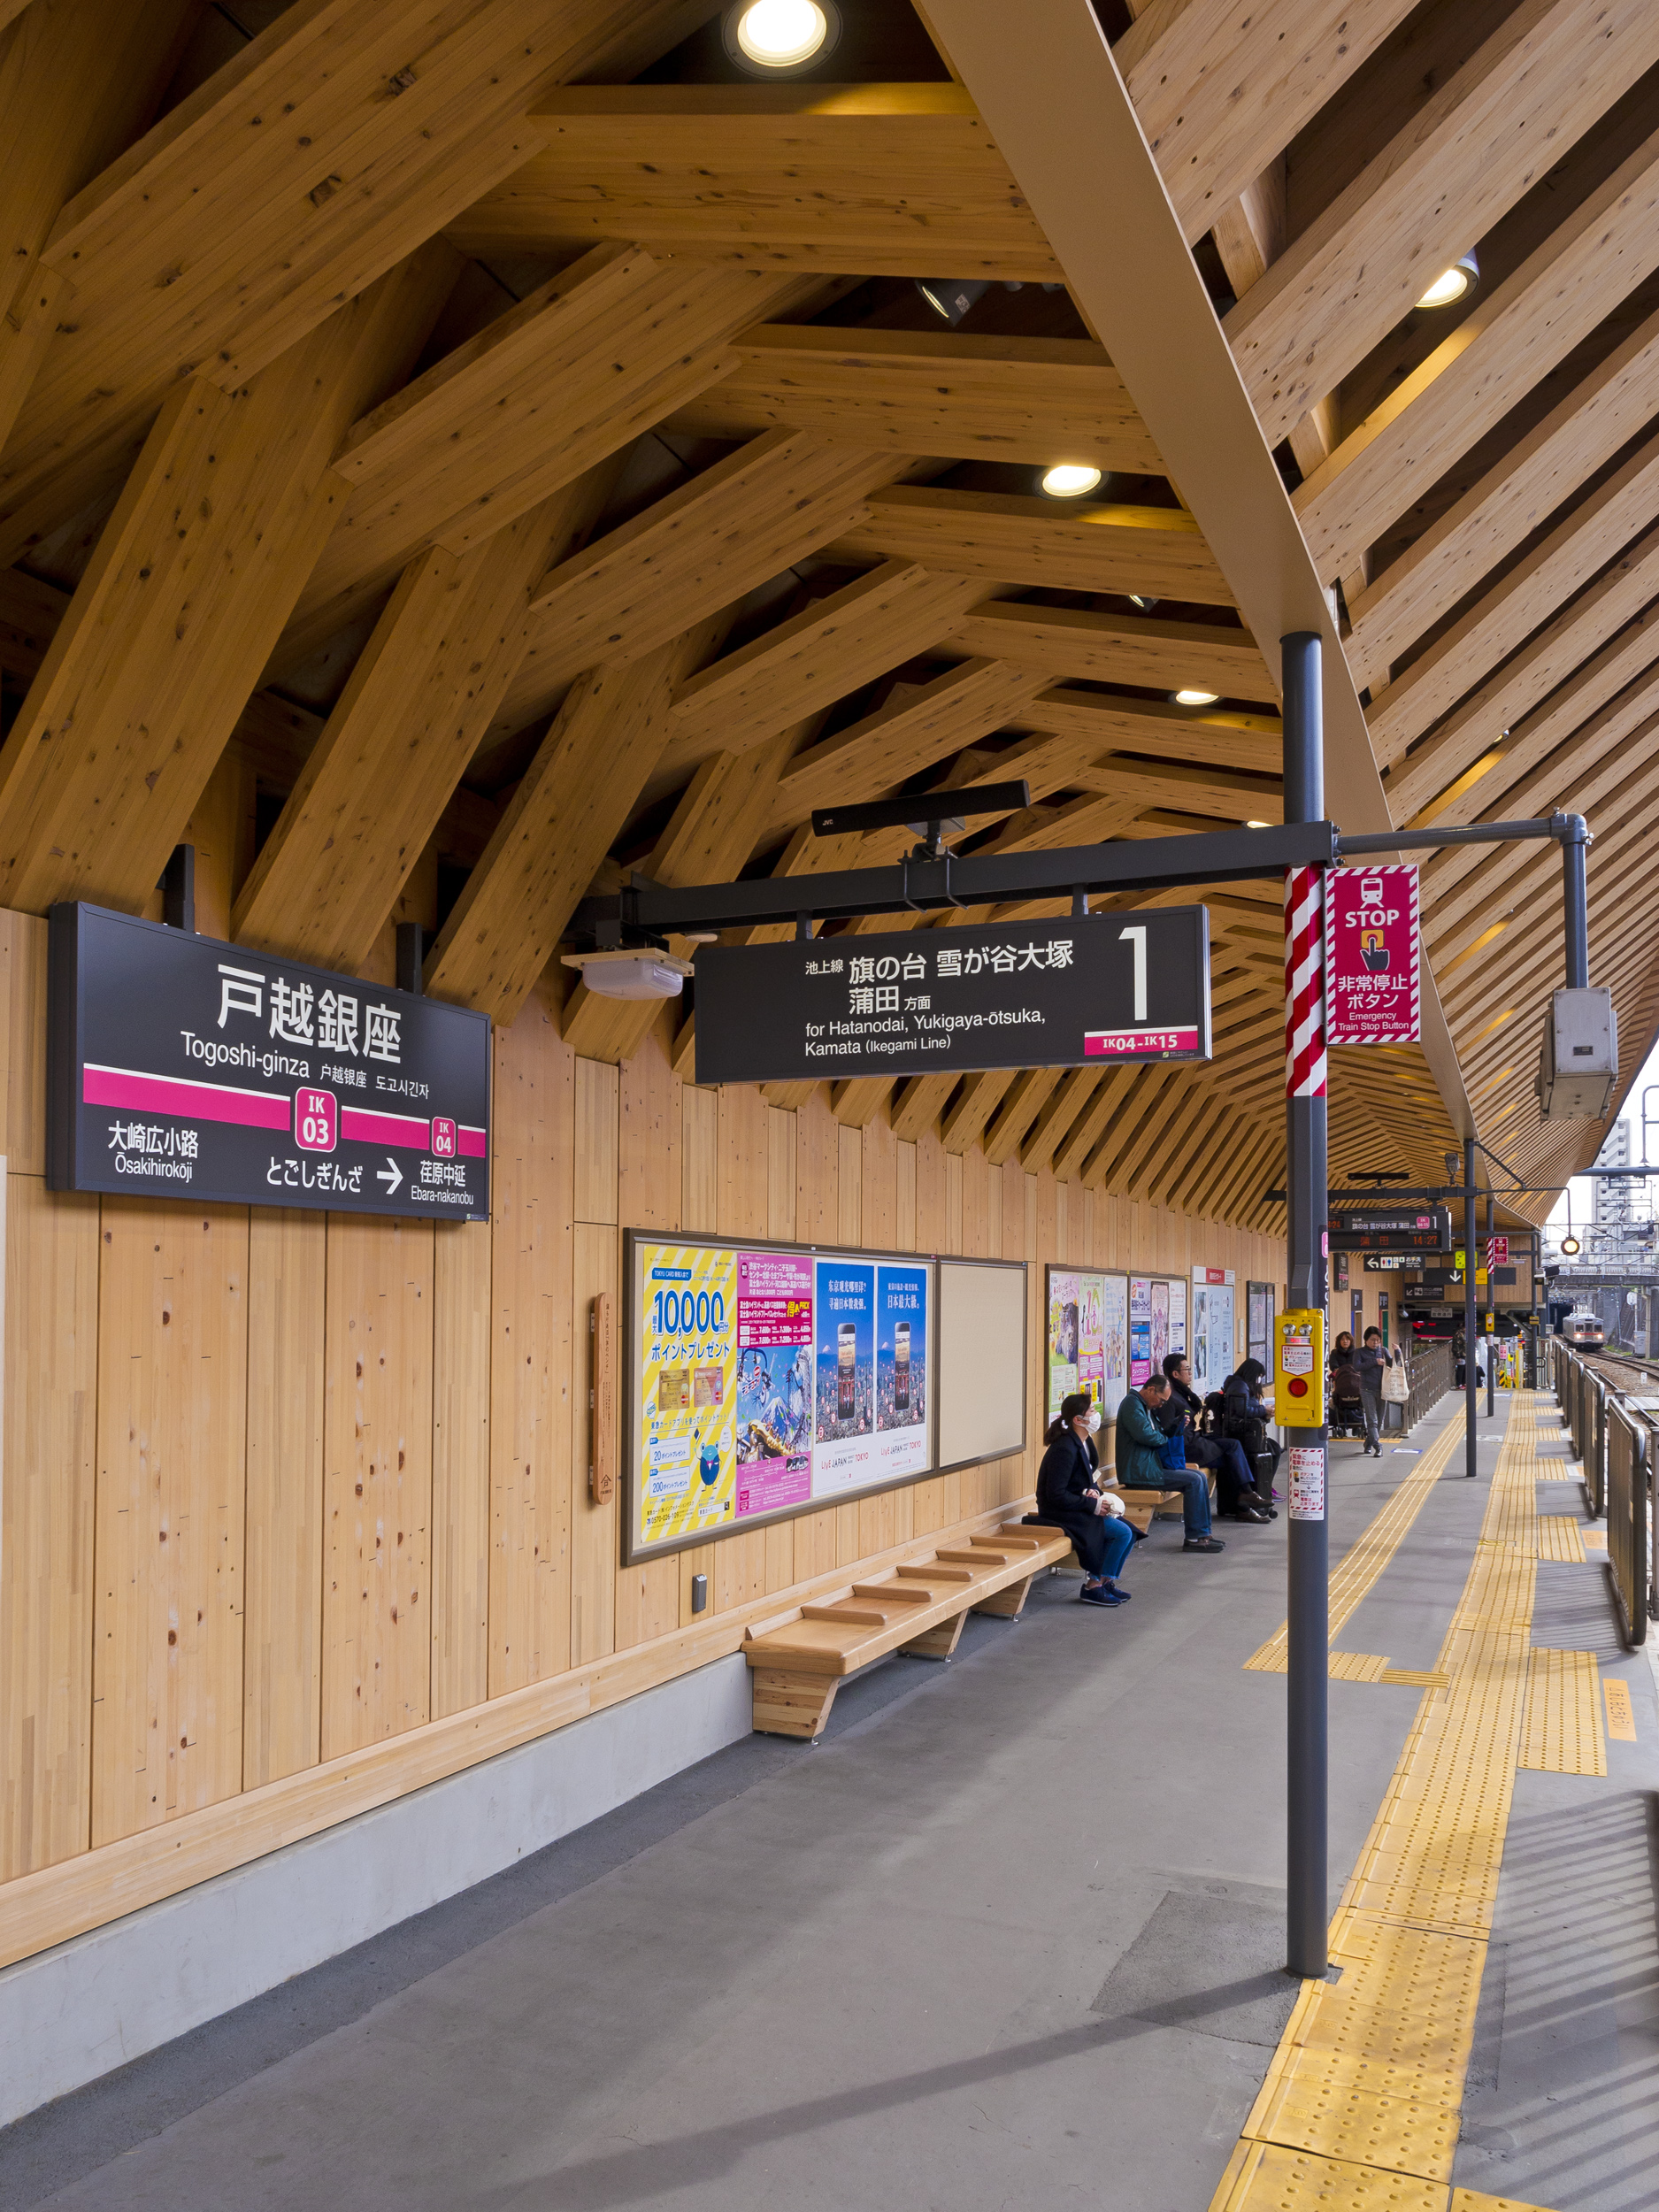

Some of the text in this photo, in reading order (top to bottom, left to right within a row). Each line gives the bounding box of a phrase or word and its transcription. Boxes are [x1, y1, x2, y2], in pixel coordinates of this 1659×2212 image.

[1345, 910, 1400, 929] STOP
[804, 940, 1074, 985] 池上線 旗の台 雪が谷大塚
[1118, 926, 1148, 1021] 1
[1338, 973, 1409, 992] 非常停止
[849, 985, 932, 1016] 蒲田 方面
[1348, 993, 1399, 1010] ボタン
[217, 963, 402, 1064] 戸越銀座
[805, 1008, 1047, 1038] for Hatanodai, Yukigaya-ōtsuka,
[1348, 1011, 1397, 1023] Emergency
[1338, 1019, 1409, 1033] Train Stop Button
[180, 1030, 311, 1079] Togoshi-ginza
[804, 1032, 953, 1057] Kamata (Ikegami Line)
[375, 1075, 430, 1101] 도고시긴자
[308, 1094, 326, 1115] IK
[108, 1119, 199, 1160] 大崎広小路
[302, 1116, 329, 1146] 03
[439, 1120, 450, 1136] IK
[435, 1135, 452, 1154] 04
[115, 1152, 194, 1184] Ōsakihirokōji
[265, 1156, 364, 1194] とごしぎんざ
[419, 1160, 467, 1188] 荏原中延
[411, 1185, 475, 1206] Ebara-nakanobu
[1432, 1216, 1438, 1229] 1
[1413, 1235, 1438, 1245] 14:27
[654, 1289, 725, 1339] 10,000
[718, 1320, 729, 1333] 円分
[651, 1340, 731, 1362] ポイントプレゼント
[890, 1442, 903, 1455] JAPAN
[909, 1440, 922, 1450] TOKYO
[832, 1455, 849, 1469] JAPAN
[855, 1451, 869, 1463] TOKYO
